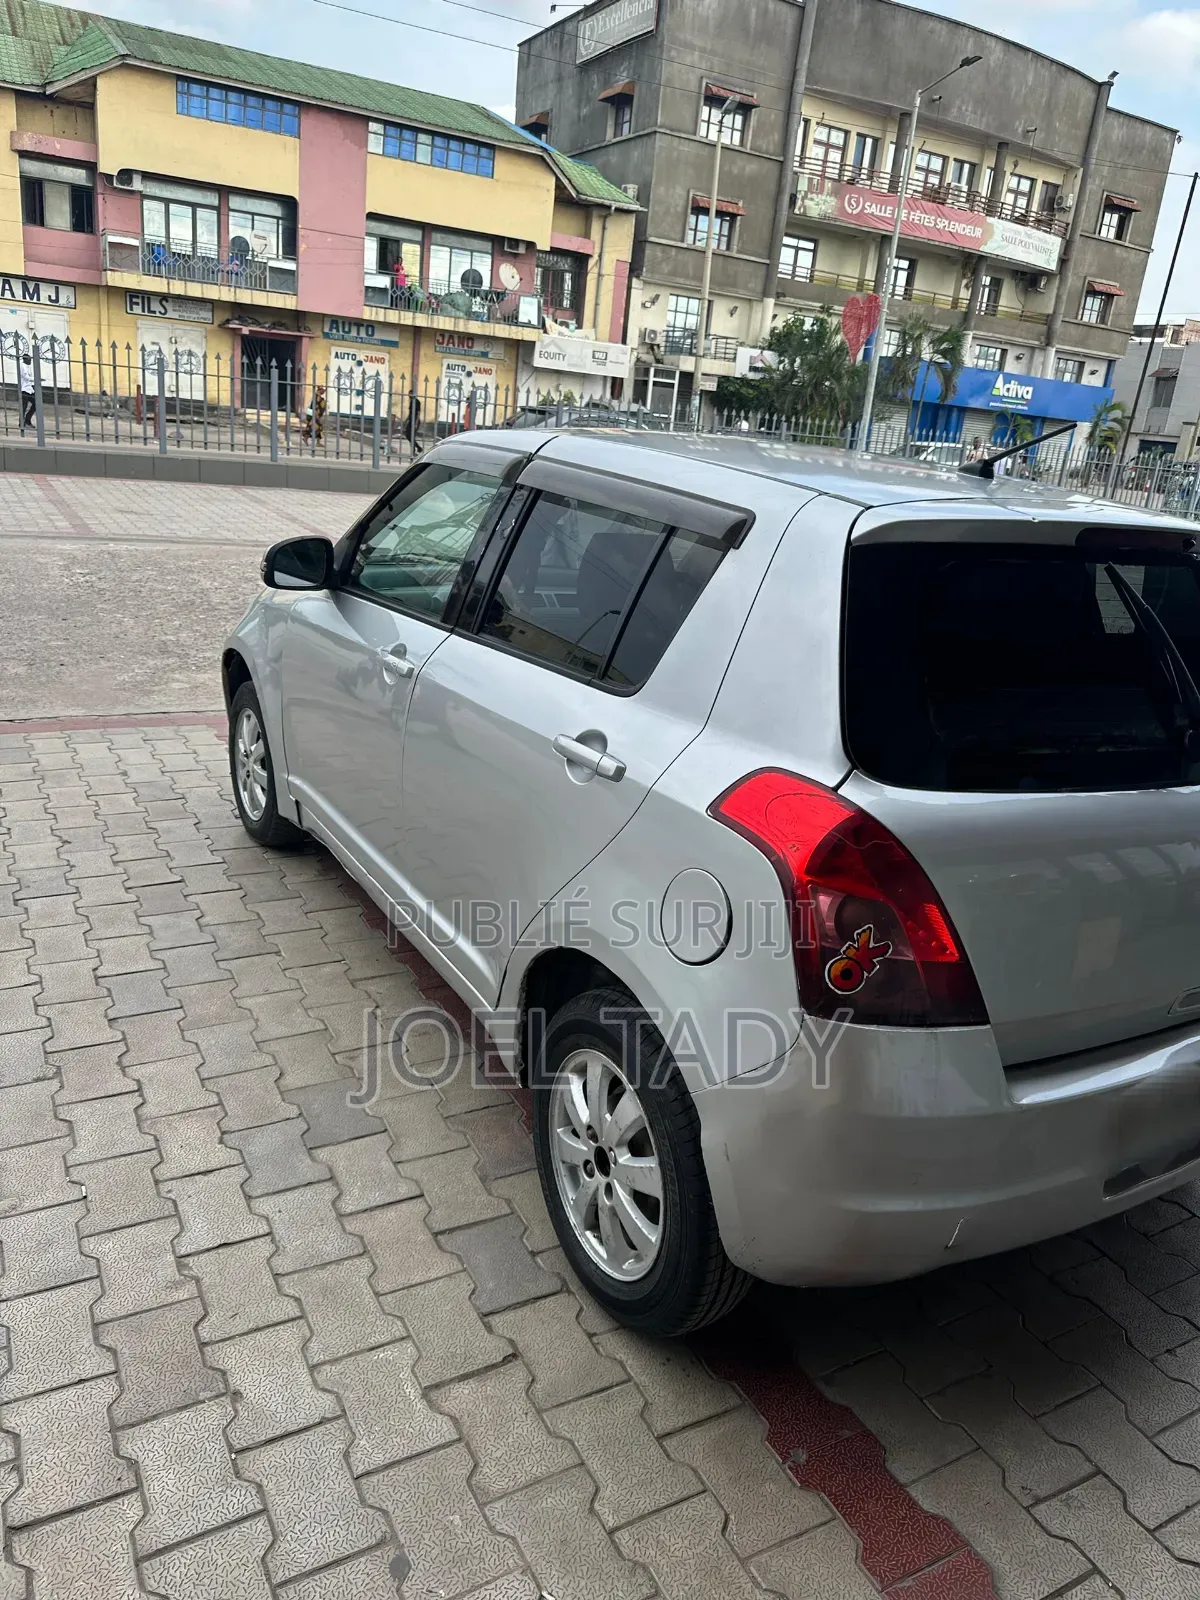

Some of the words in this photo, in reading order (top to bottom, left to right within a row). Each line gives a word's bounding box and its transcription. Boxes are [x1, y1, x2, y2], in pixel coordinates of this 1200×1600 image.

[864, 202, 893, 218] SALLE
[909, 211, 935, 227] FÊTES
[936, 218, 983, 239] SPLENDEUR
[1001, 233, 1017, 247] SALLE
[1017, 238, 1053, 257] POLYVALENTE
[128, 293, 169, 316] FILS
[328, 319, 375, 338] AUTO
[436, 333, 475, 350] JANO
[334, 351, 357, 361] AUTO
[363, 355, 386, 365] JANO
[539, 350, 567, 362] EQUITY
[446, 363, 467, 372] AUTO
[472, 366, 493, 376] JANO
[992, 373, 1034, 400] Activa
